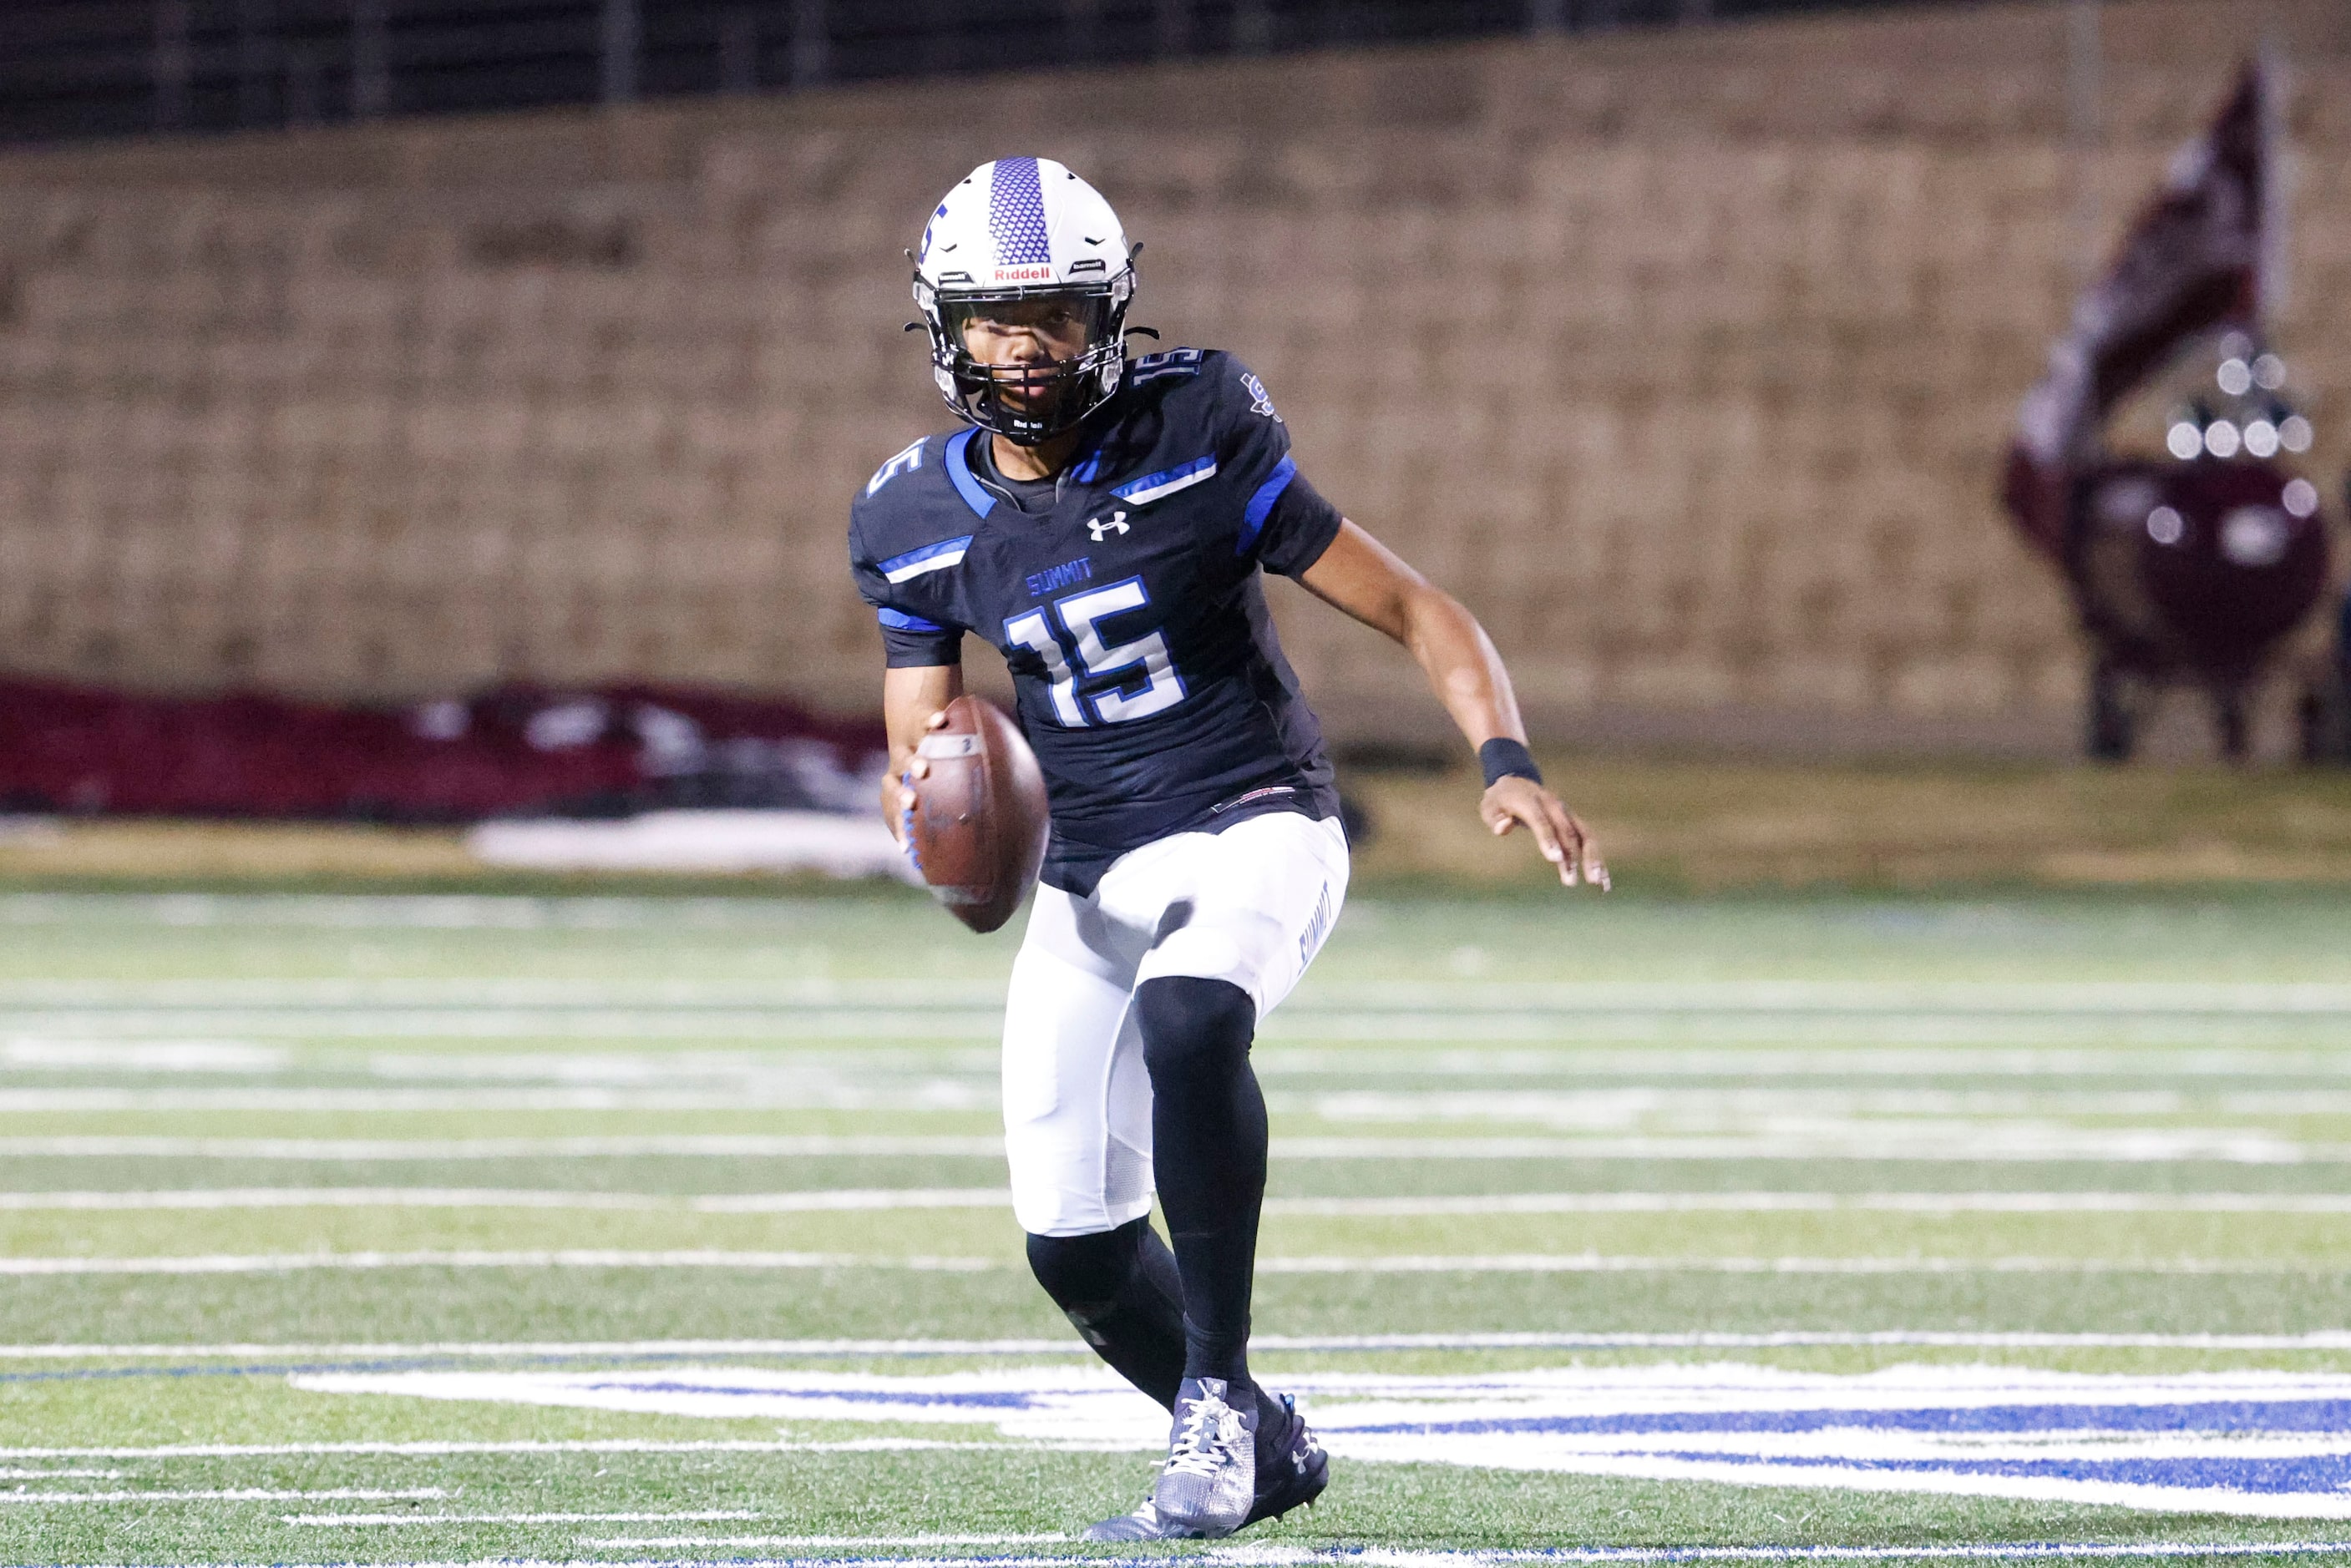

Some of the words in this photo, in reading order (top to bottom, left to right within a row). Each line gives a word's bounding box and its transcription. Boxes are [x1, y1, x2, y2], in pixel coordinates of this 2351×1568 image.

[995, 267, 1050, 281] Riddell
[1025, 556, 1093, 598] SUMMIT
[1002, 574, 1189, 728] 15
